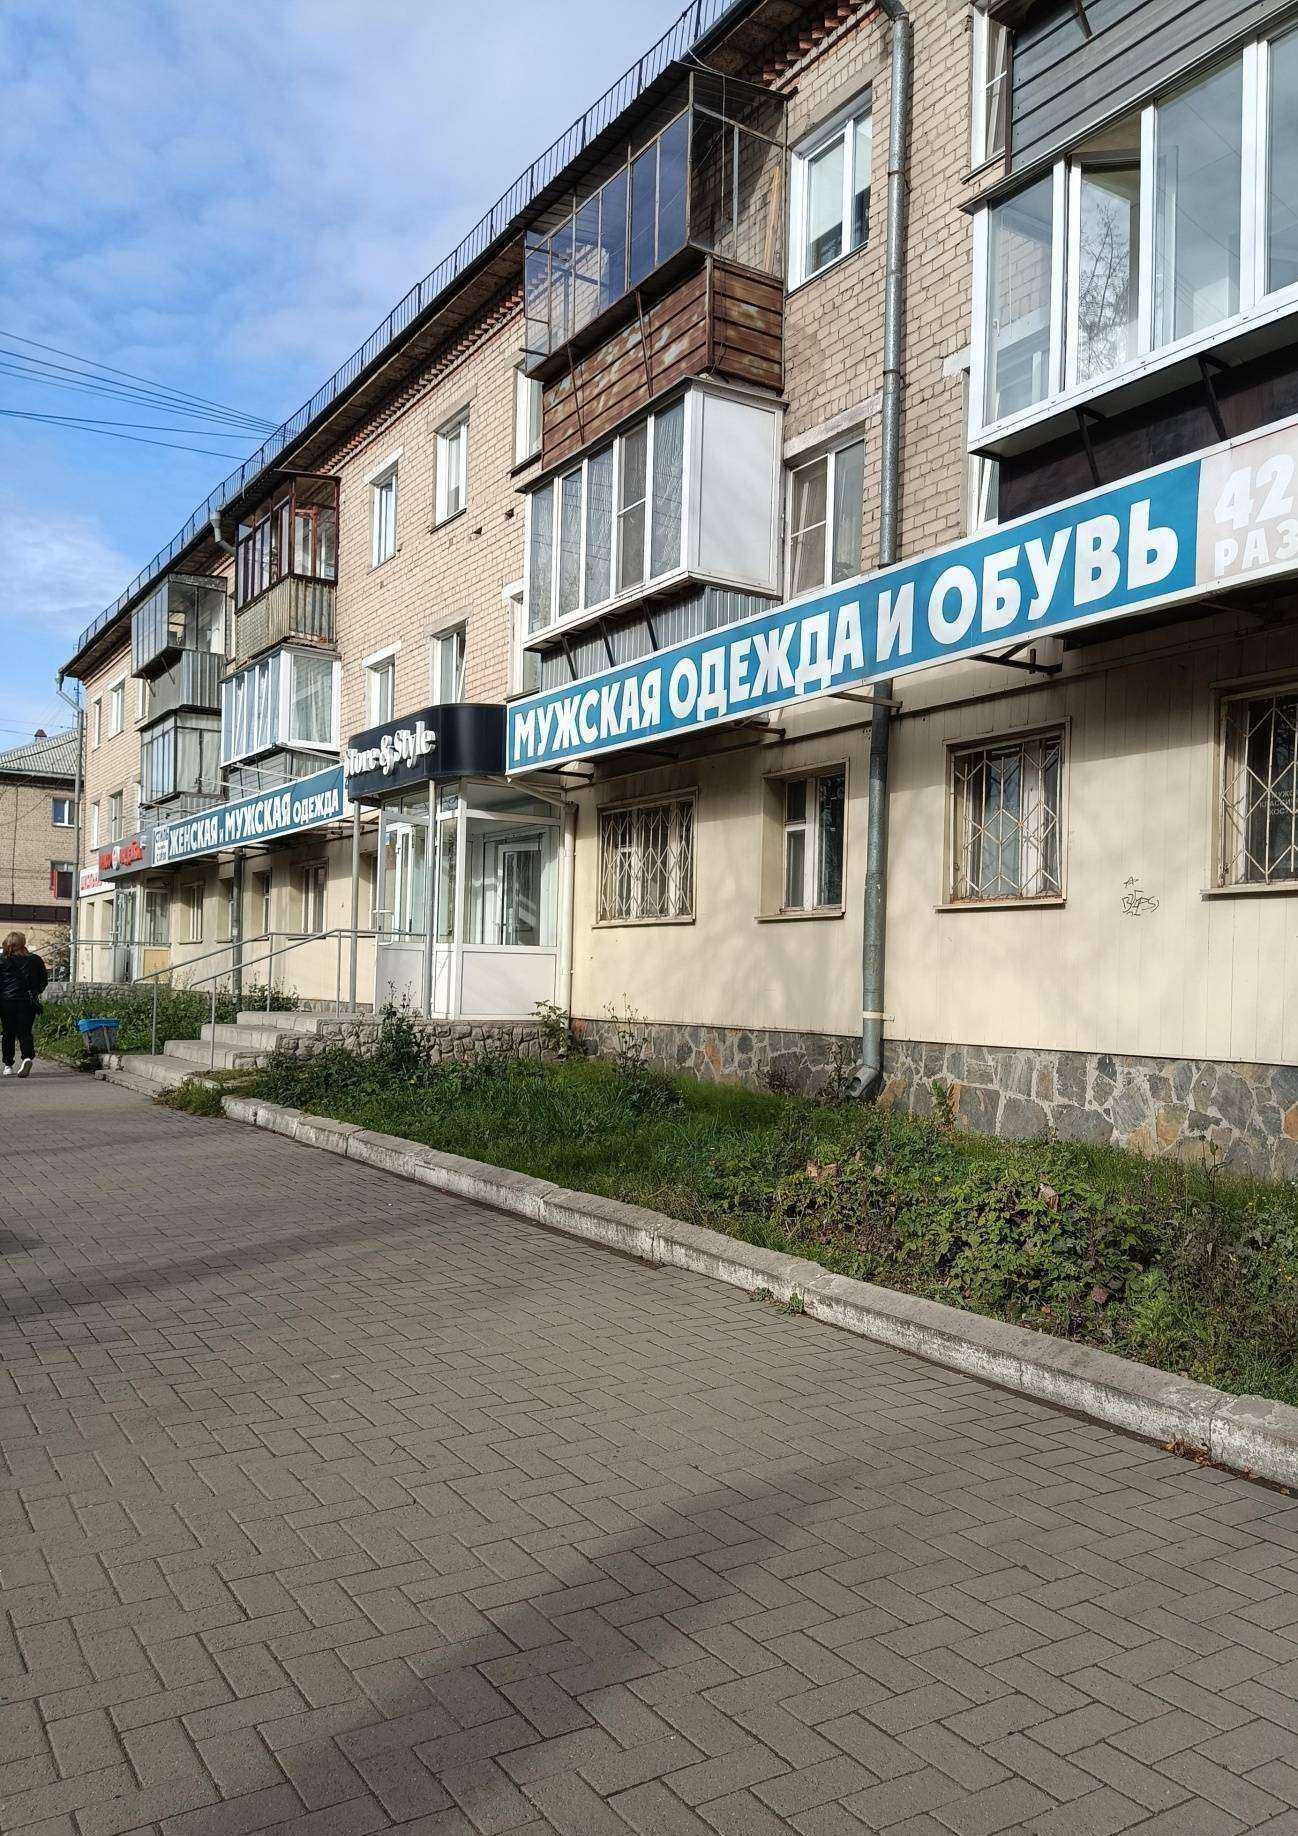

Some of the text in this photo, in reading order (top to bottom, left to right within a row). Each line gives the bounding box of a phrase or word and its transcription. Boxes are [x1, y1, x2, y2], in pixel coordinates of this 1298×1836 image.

[1214, 453, 1296, 530] 42
[513, 498, 1180, 761] МУЖСКАЯ ОДЕЖДА И ОБУВЬ
[169, 815, 218, 856] ЖЕНСКАЯ
[225, 792, 292, 842] МУЖСКАЯ
[293, 787, 340, 825] ОДЕЖДА
